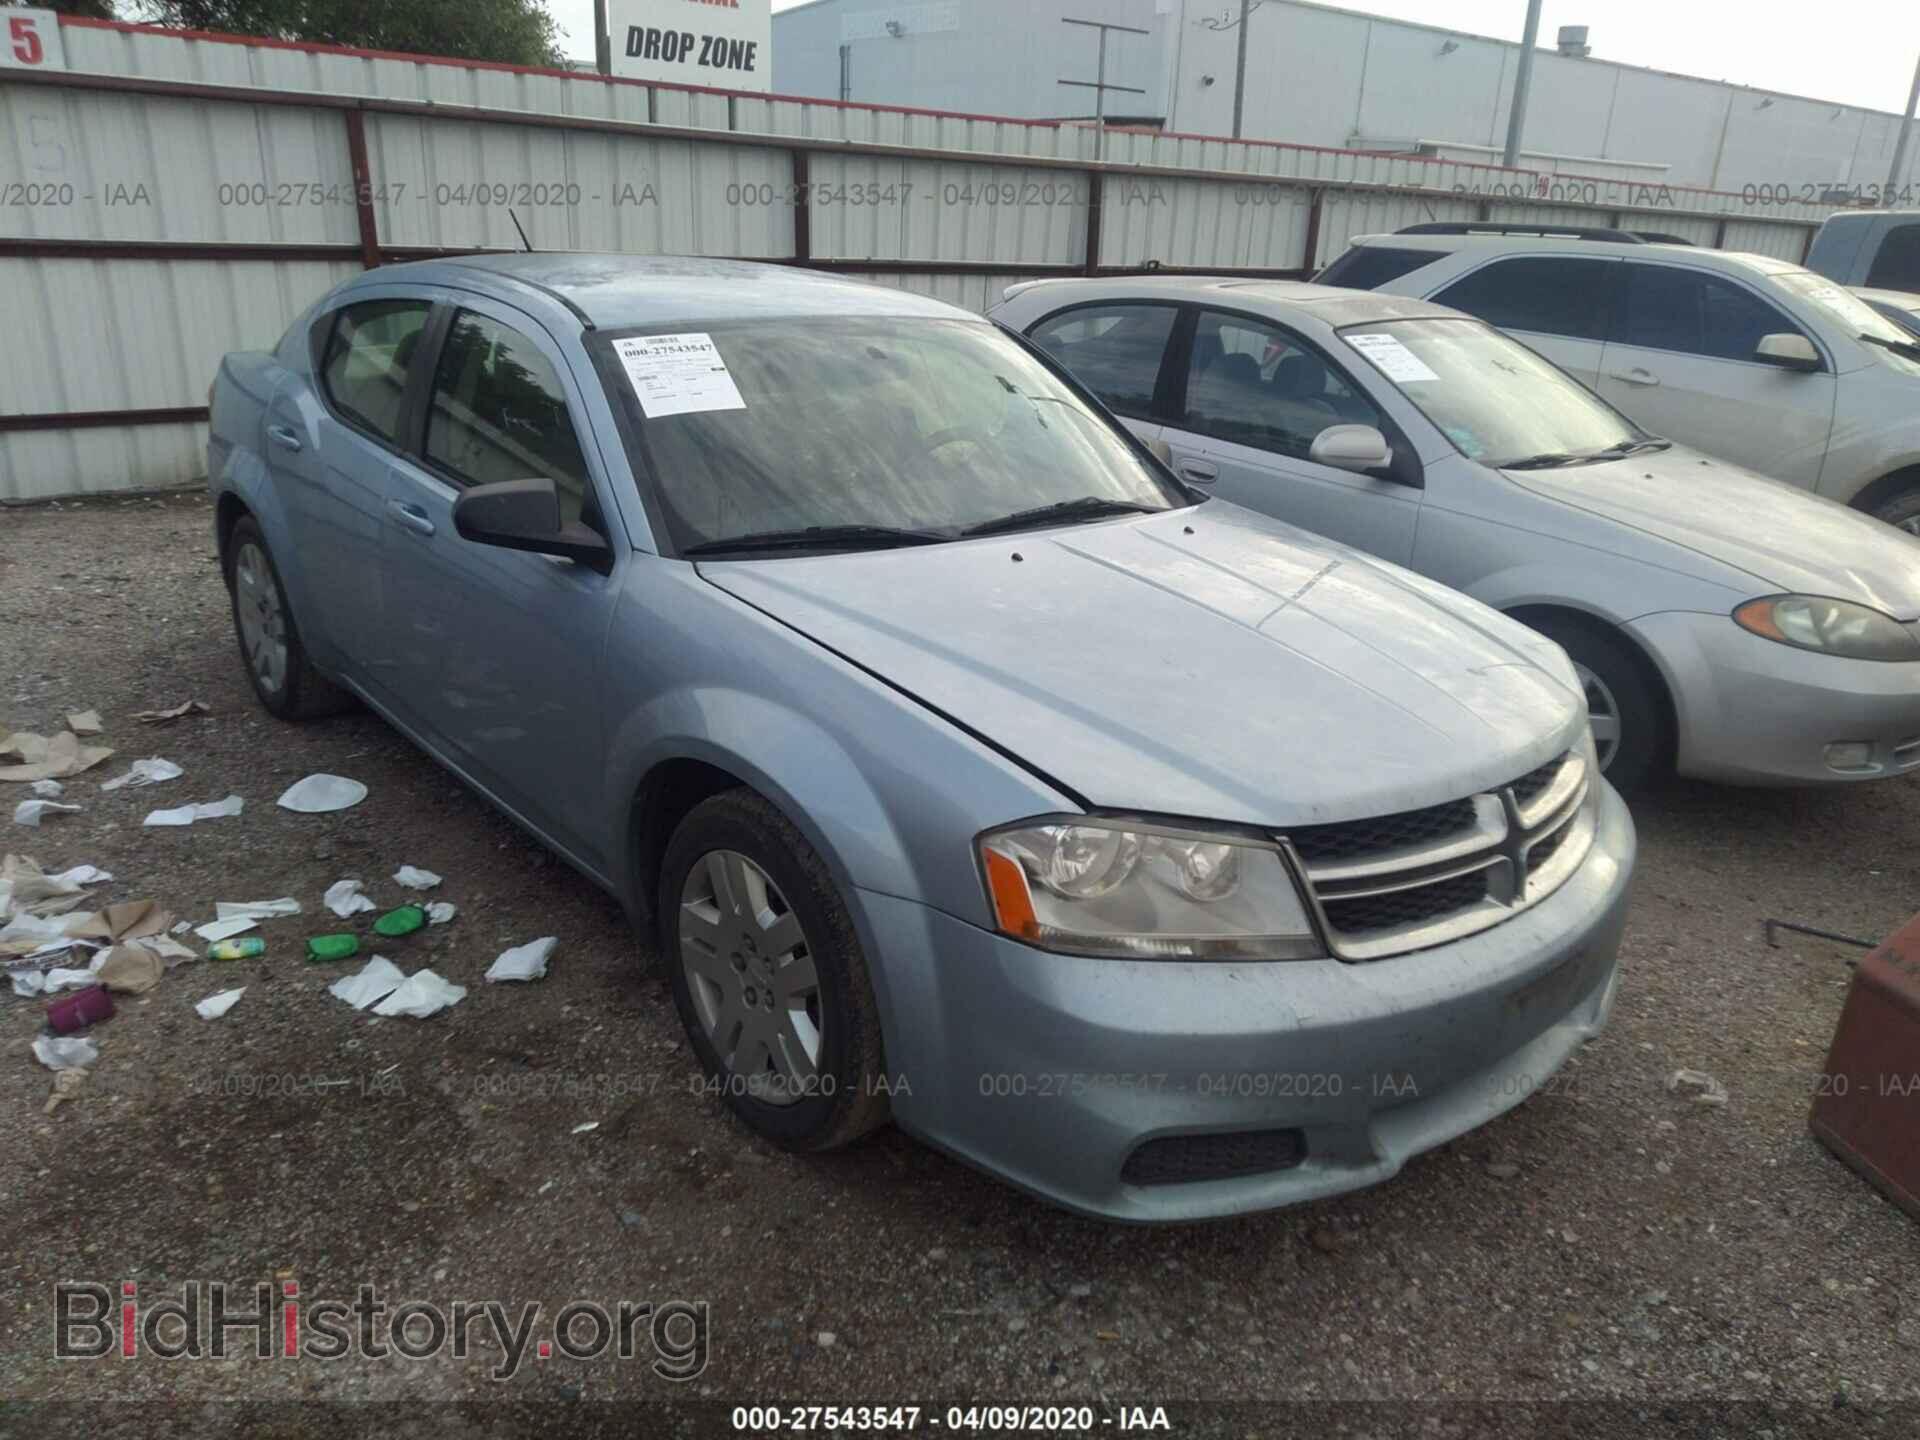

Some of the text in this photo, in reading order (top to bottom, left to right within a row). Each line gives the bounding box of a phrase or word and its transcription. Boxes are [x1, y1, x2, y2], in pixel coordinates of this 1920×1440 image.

[9, 16, 44, 65] 5
[625, 25, 757, 72] DROP ZONE
